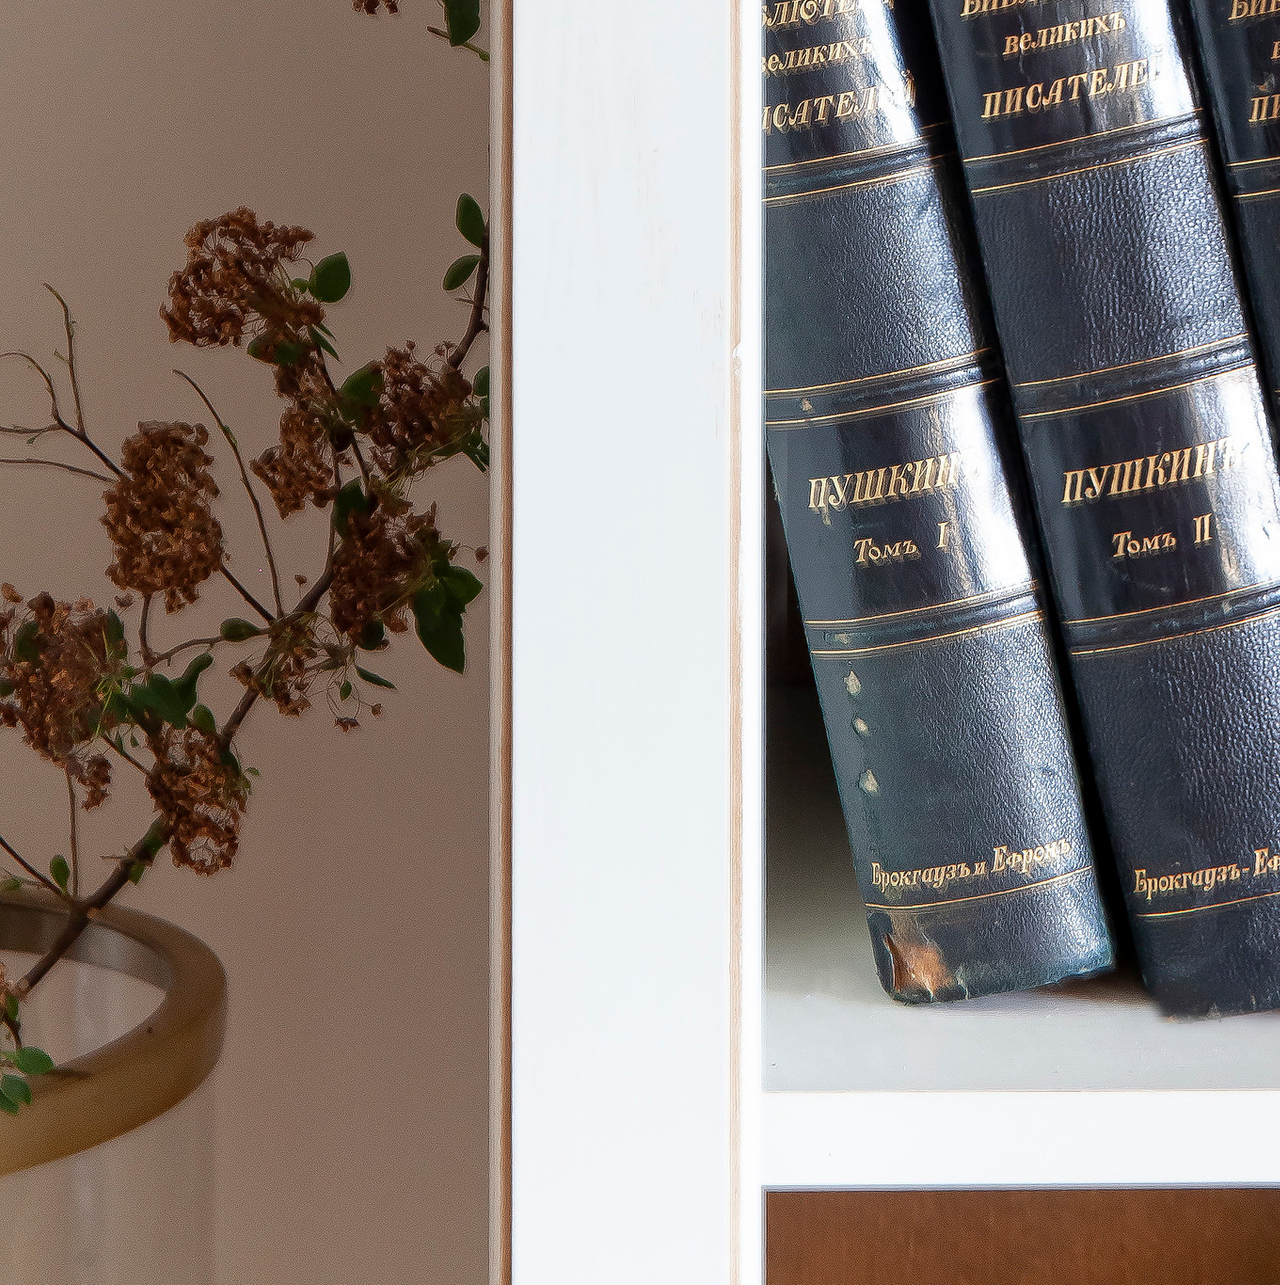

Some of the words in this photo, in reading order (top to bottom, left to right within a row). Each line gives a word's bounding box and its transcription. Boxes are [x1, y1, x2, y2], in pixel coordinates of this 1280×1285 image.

[1003, 12, 1126, 55] великихъ
[808, 451, 980, 509] ПУШКИН
[853, 537, 917, 563] Томъ
[936, 521, 949, 549] I
[1111, 531, 1177, 558] Томъ
[1192, 512, 1213, 543] II
